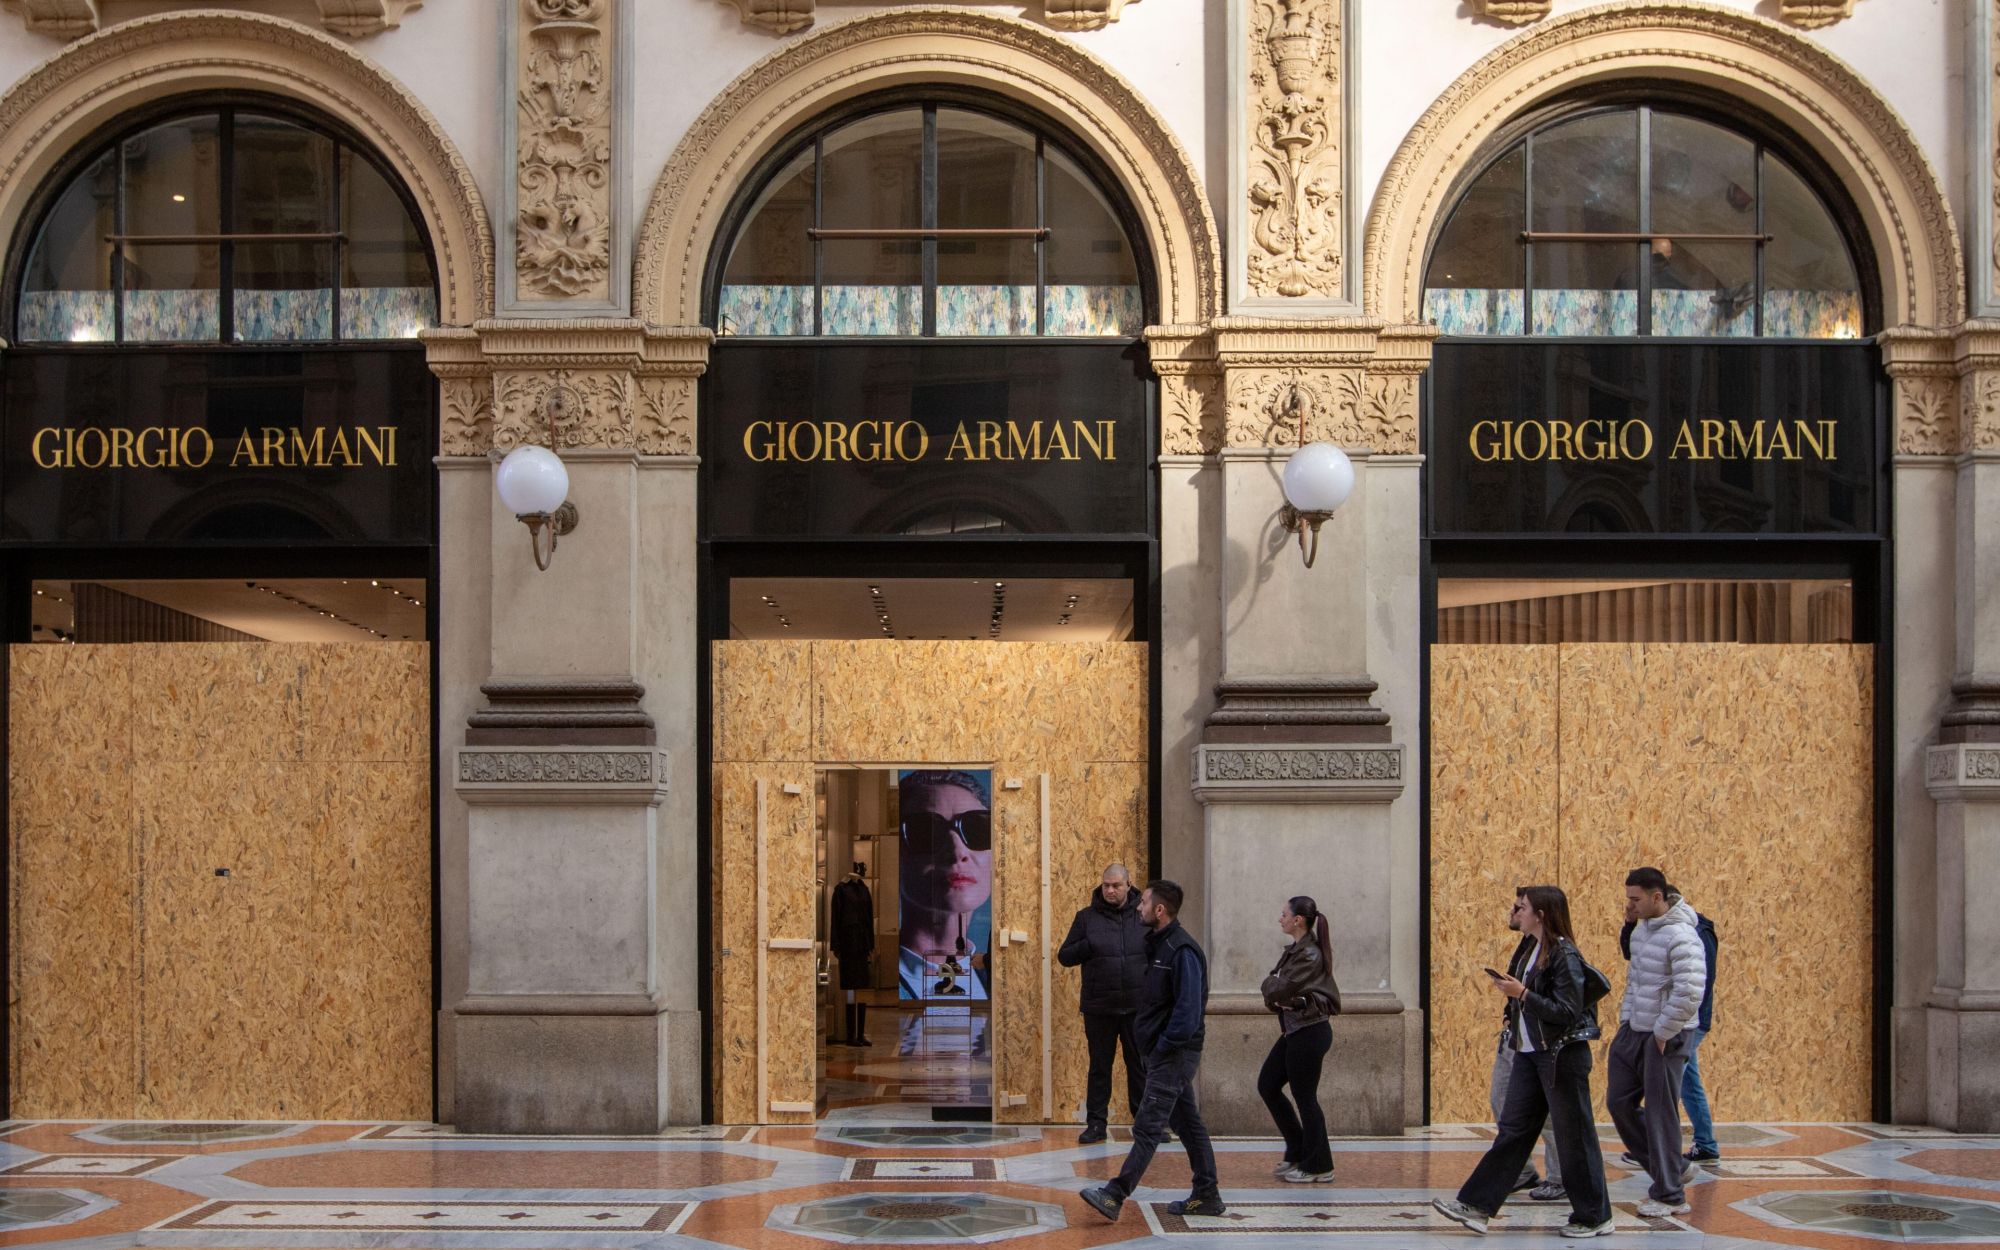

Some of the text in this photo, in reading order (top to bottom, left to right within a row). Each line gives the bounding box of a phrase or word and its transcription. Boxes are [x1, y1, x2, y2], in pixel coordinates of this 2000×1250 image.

[31, 426, 397, 468] GIORGIO ARMANI
[743, 420, 1117, 462] GIORGIO ARMANI
[1469, 419, 1838, 461] GIORGIO ARMANI
